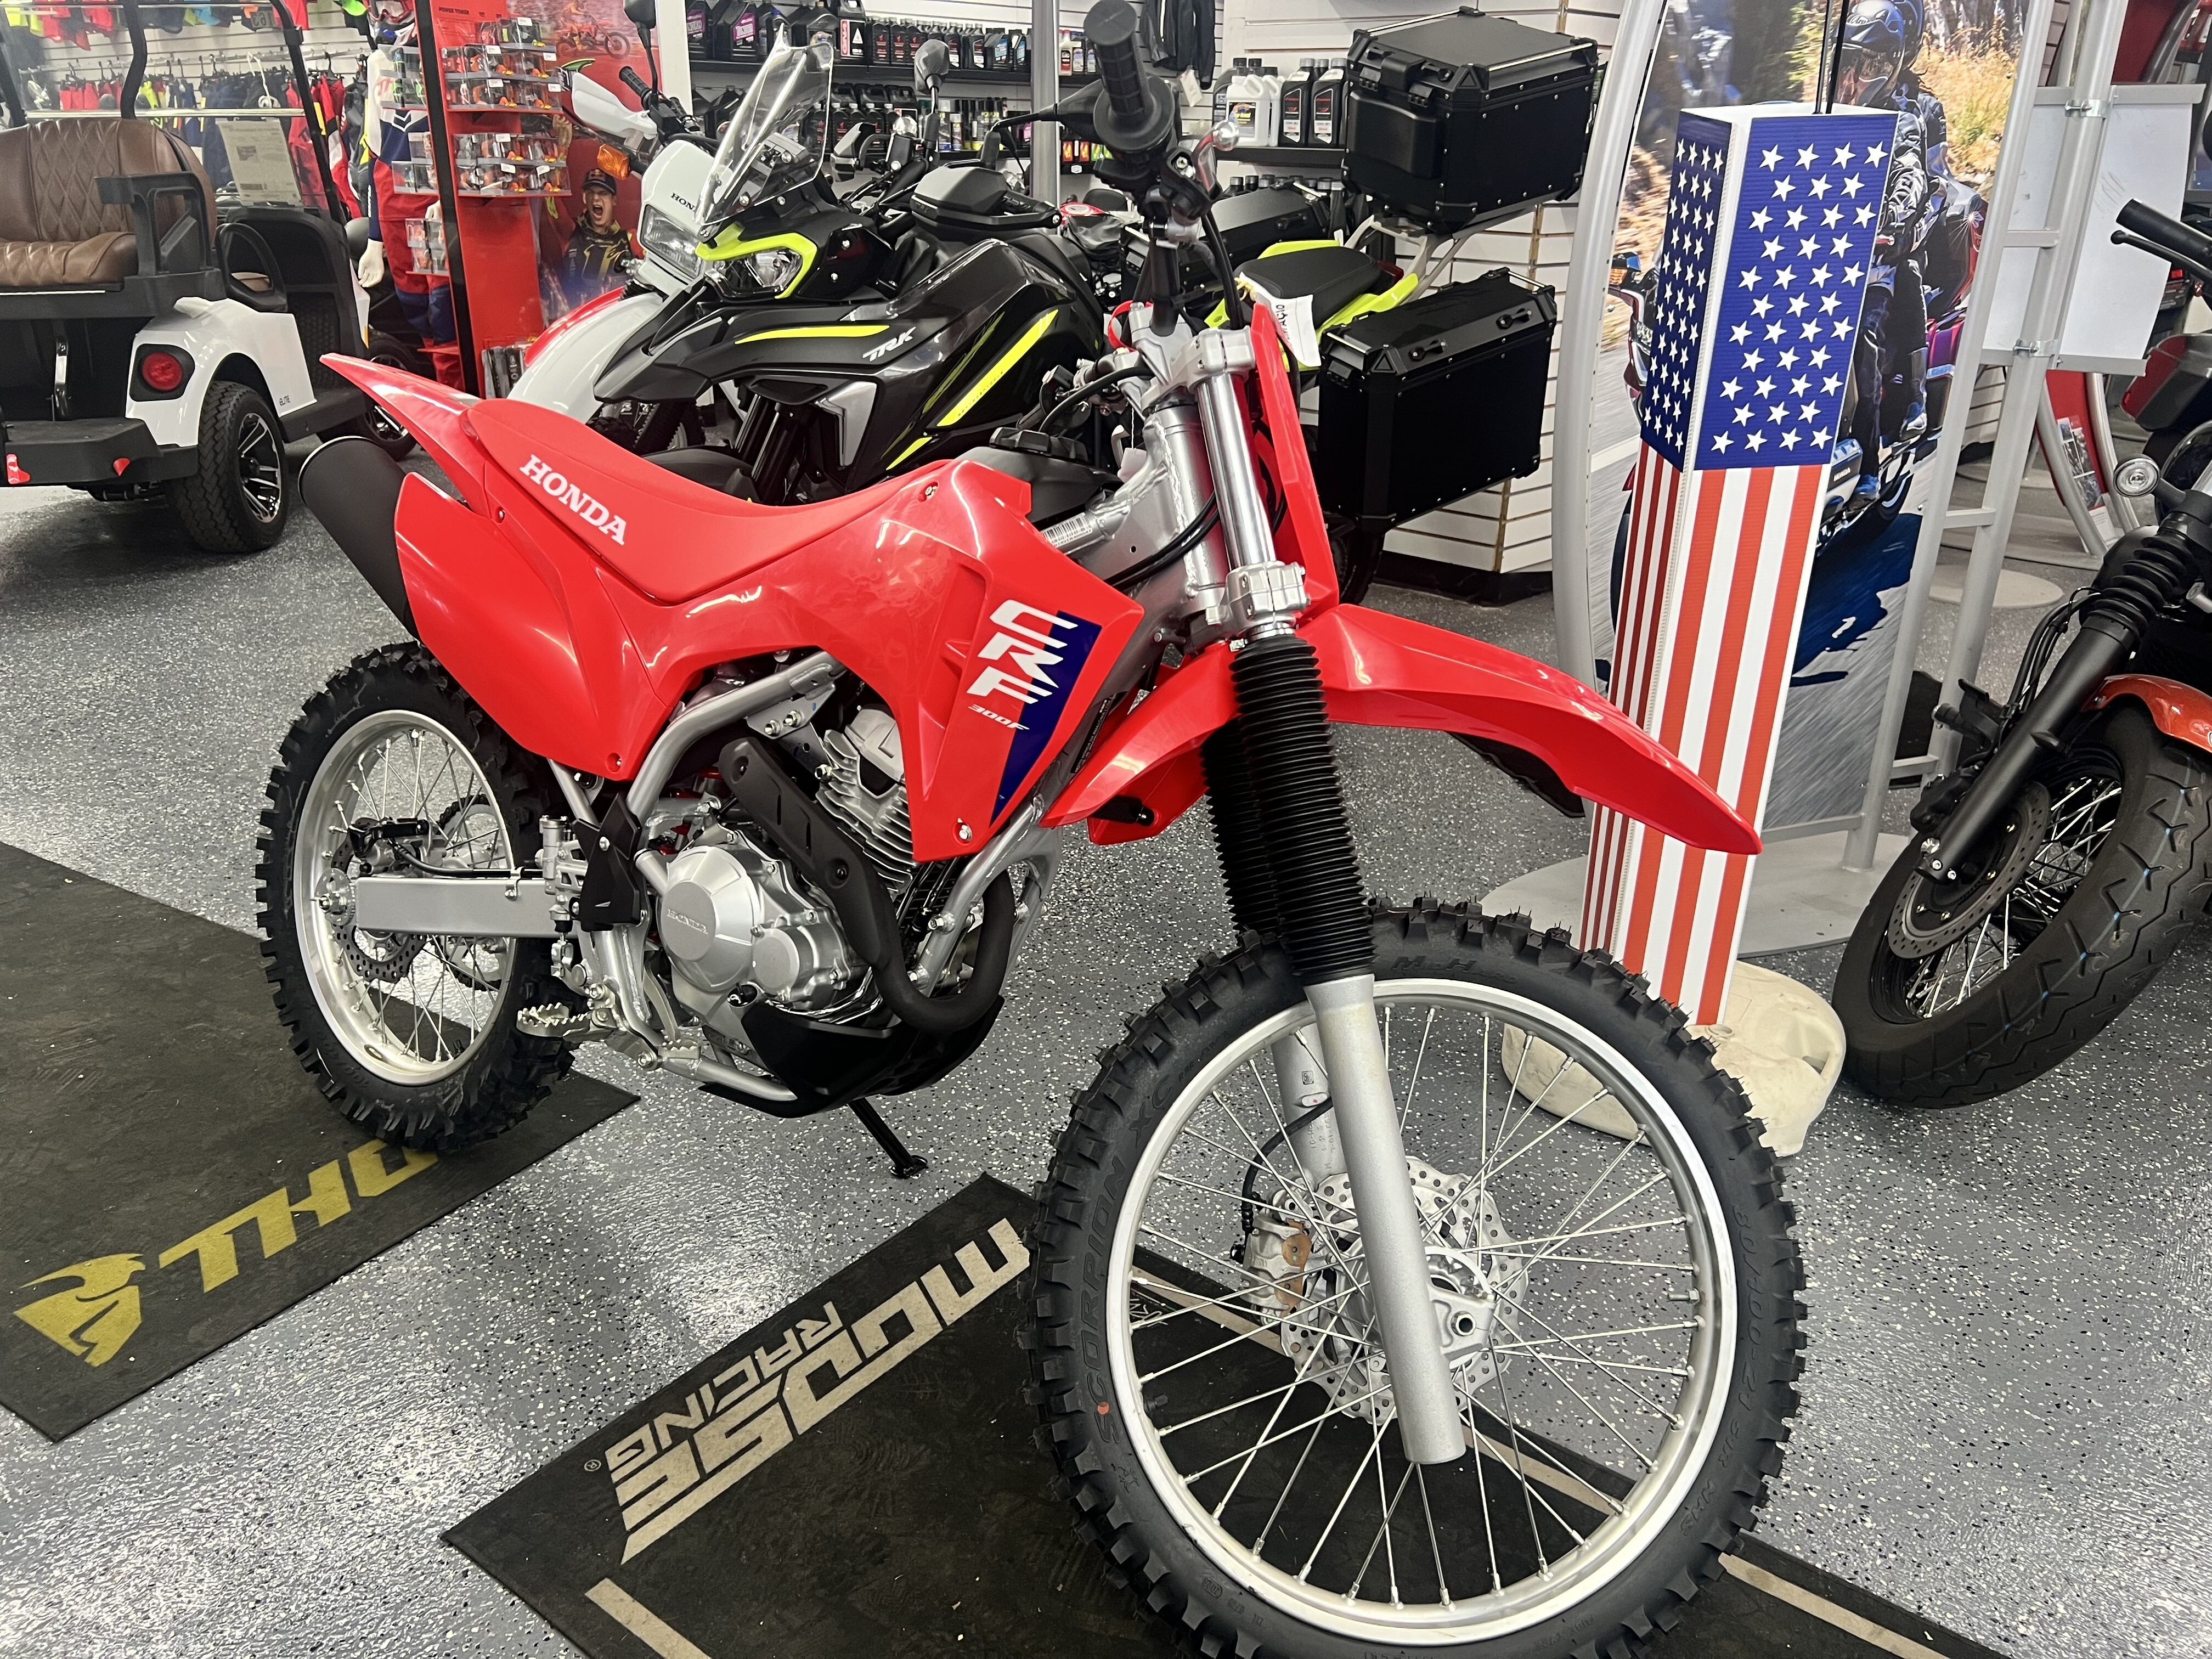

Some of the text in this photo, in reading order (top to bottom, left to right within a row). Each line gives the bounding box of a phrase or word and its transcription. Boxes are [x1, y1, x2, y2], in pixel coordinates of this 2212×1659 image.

[670, 192, 696, 212] HON
[862, 326, 916, 362] TRK
[519, 454, 627, 546] HONDA
[966, 599, 1079, 704] CRF
[968, 703, 1030, 730] 300F
[667, 908, 709, 934] HONDA
[158, 1138, 440, 1293] THO
[604, 1301, 848, 1472] RACING
[610, 1217, 1031, 1566] MOOSE
